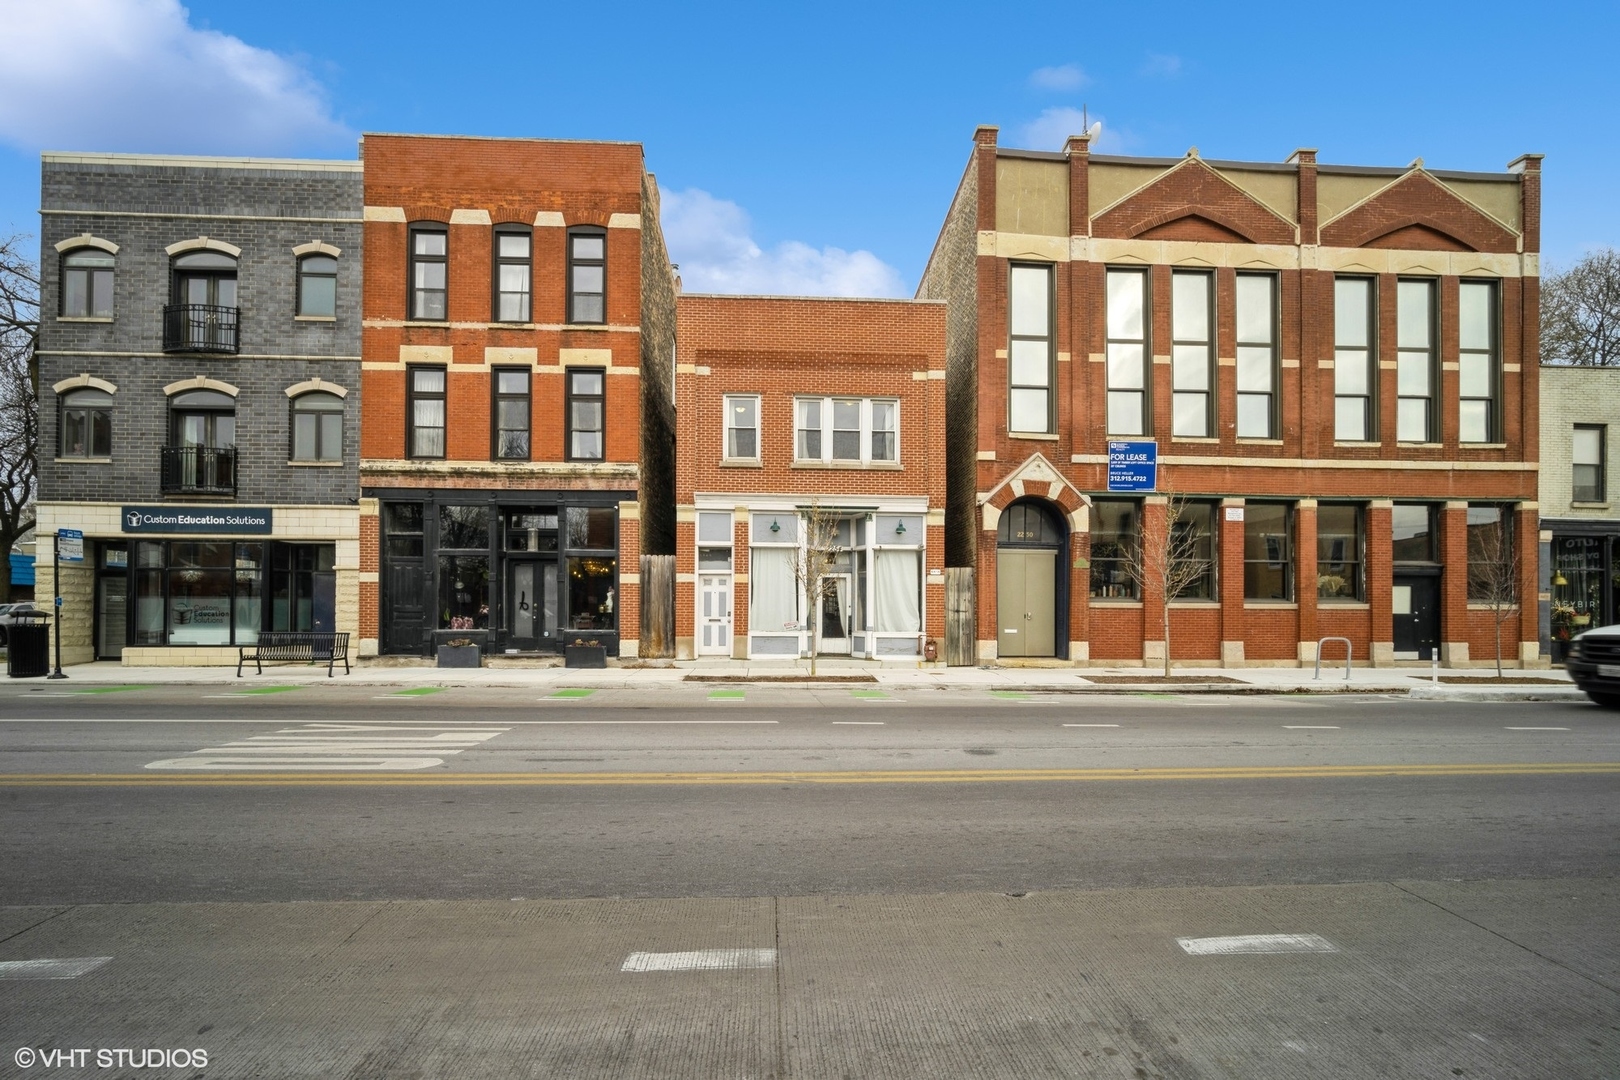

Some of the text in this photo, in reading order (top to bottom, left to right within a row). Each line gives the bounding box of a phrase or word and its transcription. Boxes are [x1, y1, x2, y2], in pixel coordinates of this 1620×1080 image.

[144, 515, 265, 525] Custom Education Solutions
